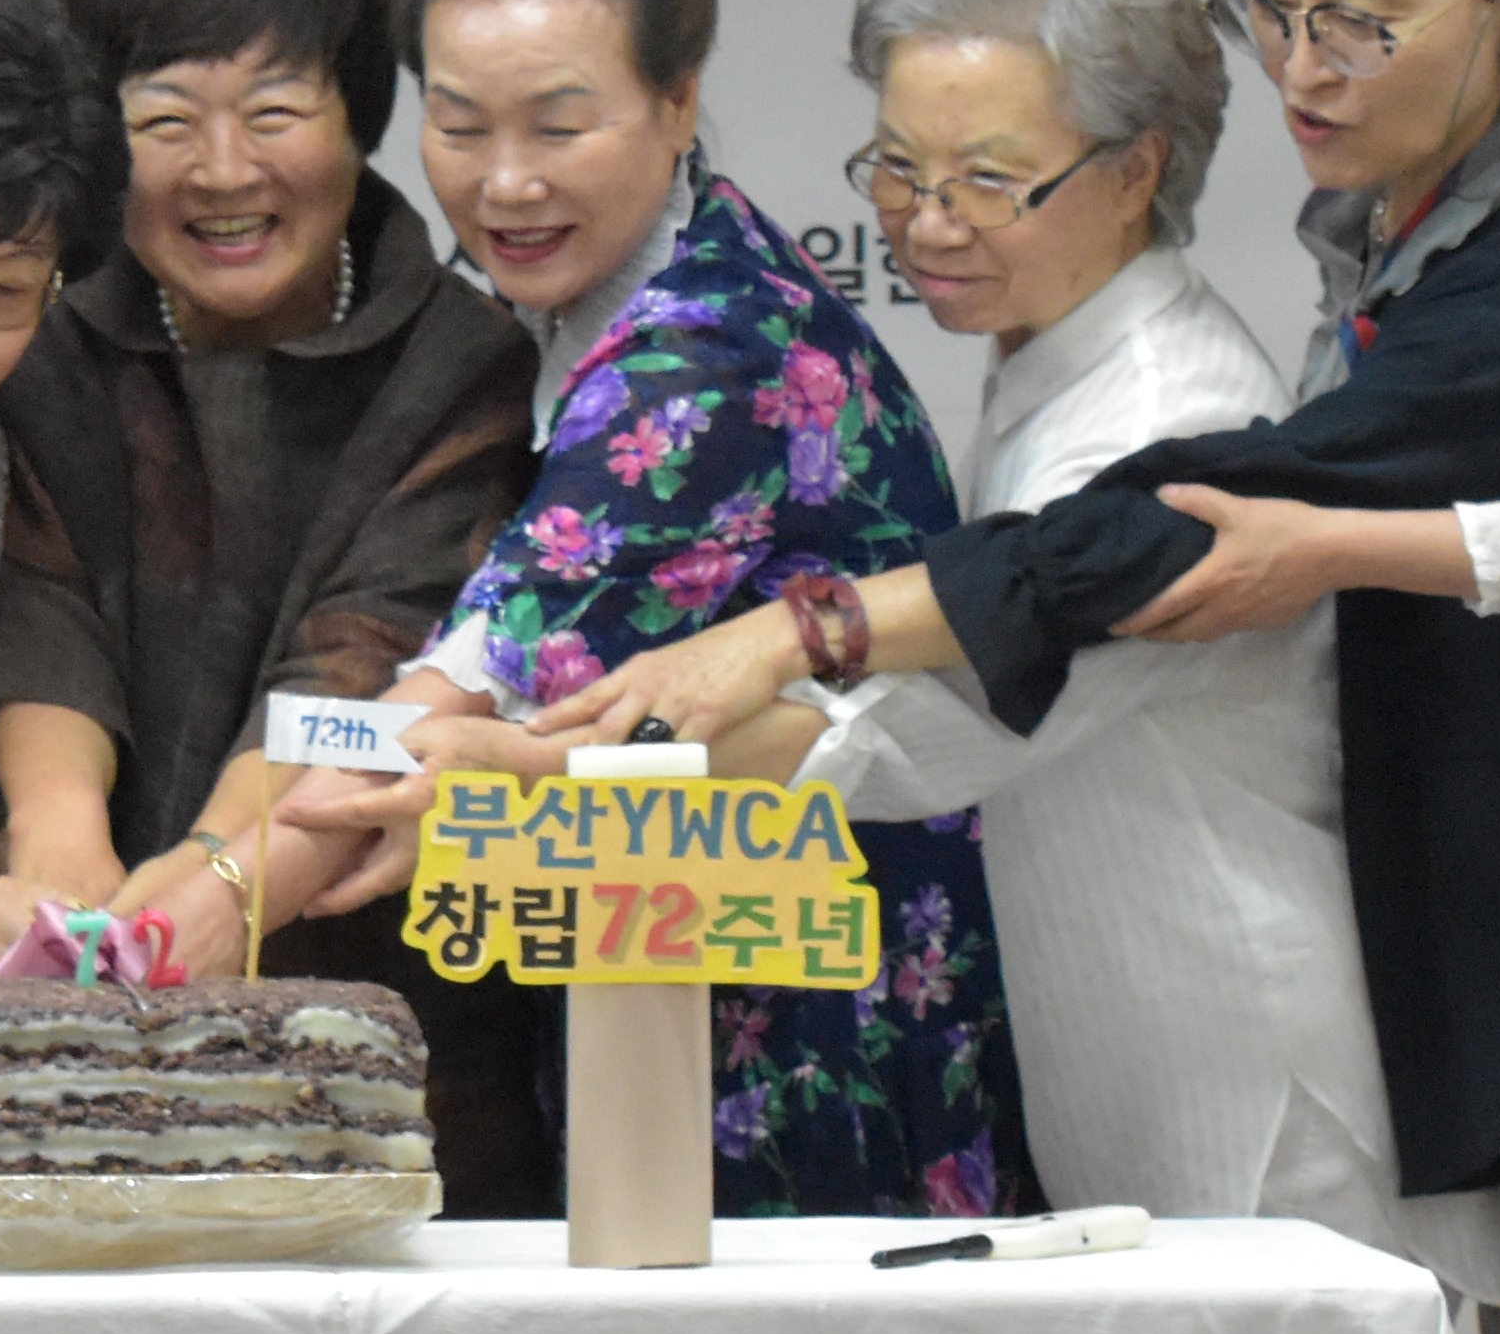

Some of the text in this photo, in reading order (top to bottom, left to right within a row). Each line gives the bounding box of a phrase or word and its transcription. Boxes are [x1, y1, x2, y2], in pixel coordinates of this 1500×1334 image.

[300, 715, 377, 752] 72th
[437, 784, 850, 870] 부산YWCA
[415, 881, 867, 980] 창립72주년
